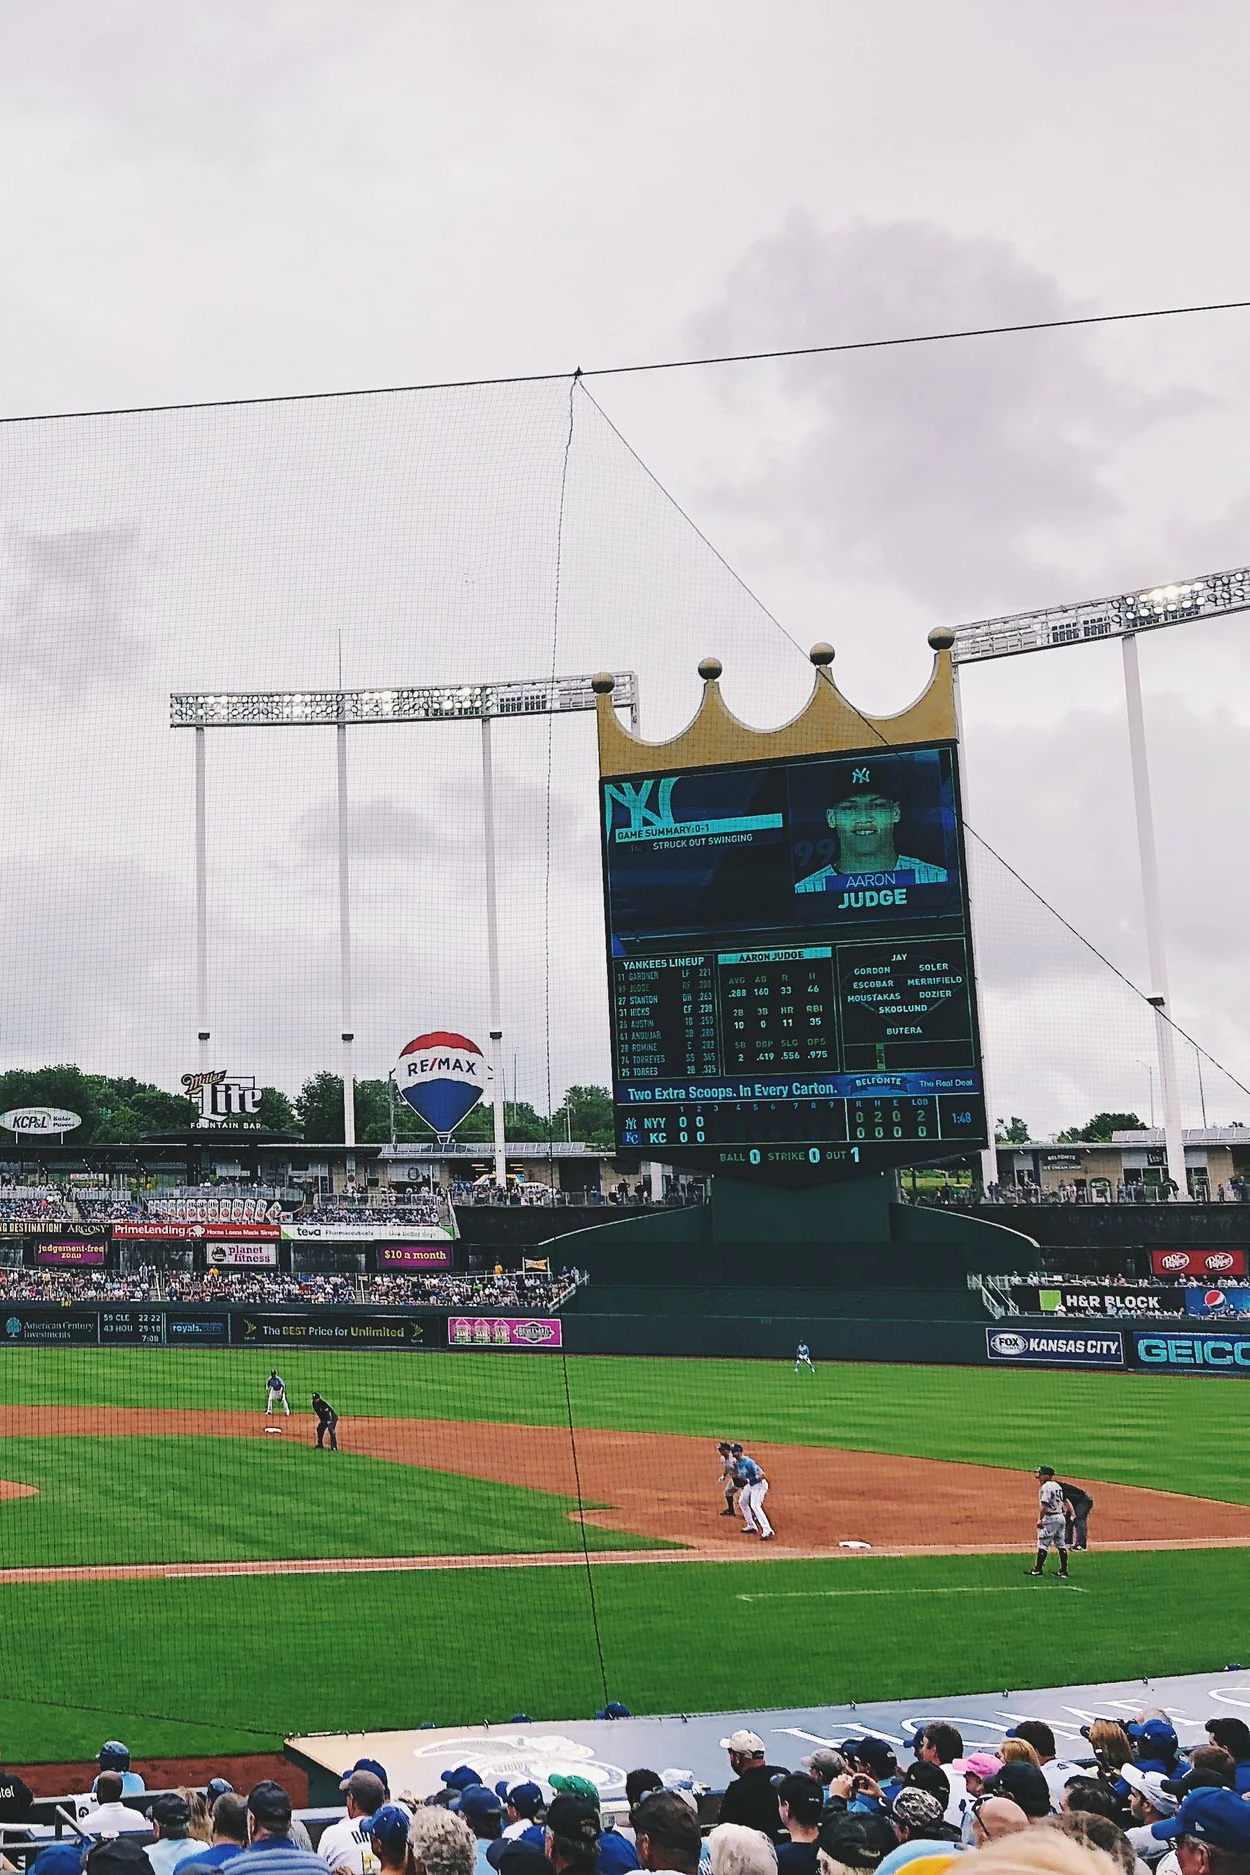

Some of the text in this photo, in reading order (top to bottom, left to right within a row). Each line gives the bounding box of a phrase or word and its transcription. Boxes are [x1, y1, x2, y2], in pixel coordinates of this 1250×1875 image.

[618, 830, 643, 840] GAME
[653, 834, 753, 850] STRUCK OUT SWINGING
[846, 873, 896, 888] AARON
[838, 888, 908, 910] JUDGE
[739, 951, 804, 962] AARON JUDGE
[891, 954, 908, 962] JAY
[623, 957, 704, 971] YANKEES LINEUP
[854, 963, 948, 975] GORDON SOLER
[853, 976, 962, 989] ESCOBAR MERRIFIELD
[728, 989, 747, 998] .288
[754, 987, 769, 996] 160
[781, 986, 792, 995] 33
[847, 990, 952, 1002] MOUSTAKAS DOZIER
[733, 1008, 744, 1017] 2B
[781, 1006, 794, 1014] HR
[806, 1005, 823, 1013] RBI
[879, 1005, 927, 1014] SKOGLUND
[734, 1017, 821, 1029] 10 0 11 35
[886, 1026, 922, 1035] BUTERA
[738, 1050, 828, 1062] 2 .556 .975
[408, 1057, 476, 1078] RE/MAX
[181, 1069, 227, 1092] Miller
[855, 1076, 902, 1087] BELFONTE
[919, 1080, 934, 1088] The
[936, 1079, 951, 1087] Real
[628, 1082, 838, 1101] Two Extra Scoops. In Every Carton.
[198, 1081, 263, 1121] Lite
[912, 1098, 928, 1106] LOB
[12, 1115, 48, 1129] KCP&L
[644, 1116, 704, 1129] NYY 0 0
[951, 1112, 972, 1124] 1:48
[243, 1122, 261, 1130] BAR
[650, 1132, 667, 1144] KC
[679, 1131, 688, 1143] 0
[696, 1131, 705, 1142] 0
[720, 1146, 860, 1165] BALL 0 STRIKE 0 OUT 1
[9, 1222, 62, 1233] DESTINATION!
[66, 1224, 106, 1235] ARGOSY
[114, 1225, 186, 1237] PrimeLending
[296, 1227, 321, 1237] teva
[228, 1245, 263, 1255] planet
[384, 1249, 402, 1260] $10
[412, 1250, 447, 1260] month
[234, 1253, 271, 1263] fitness
[1066, 1294, 1160, 1309] H&R BLOCK
[23, 1321, 94, 1333] American Century
[262, 1326, 404, 1337] The BEST Price for Unlimited
[23, 1330, 71, 1339] Investments
[999, 1337, 1119, 1354] FOX KANSAS CITY
[1138, 1338, 1250, 1366] GEICO
